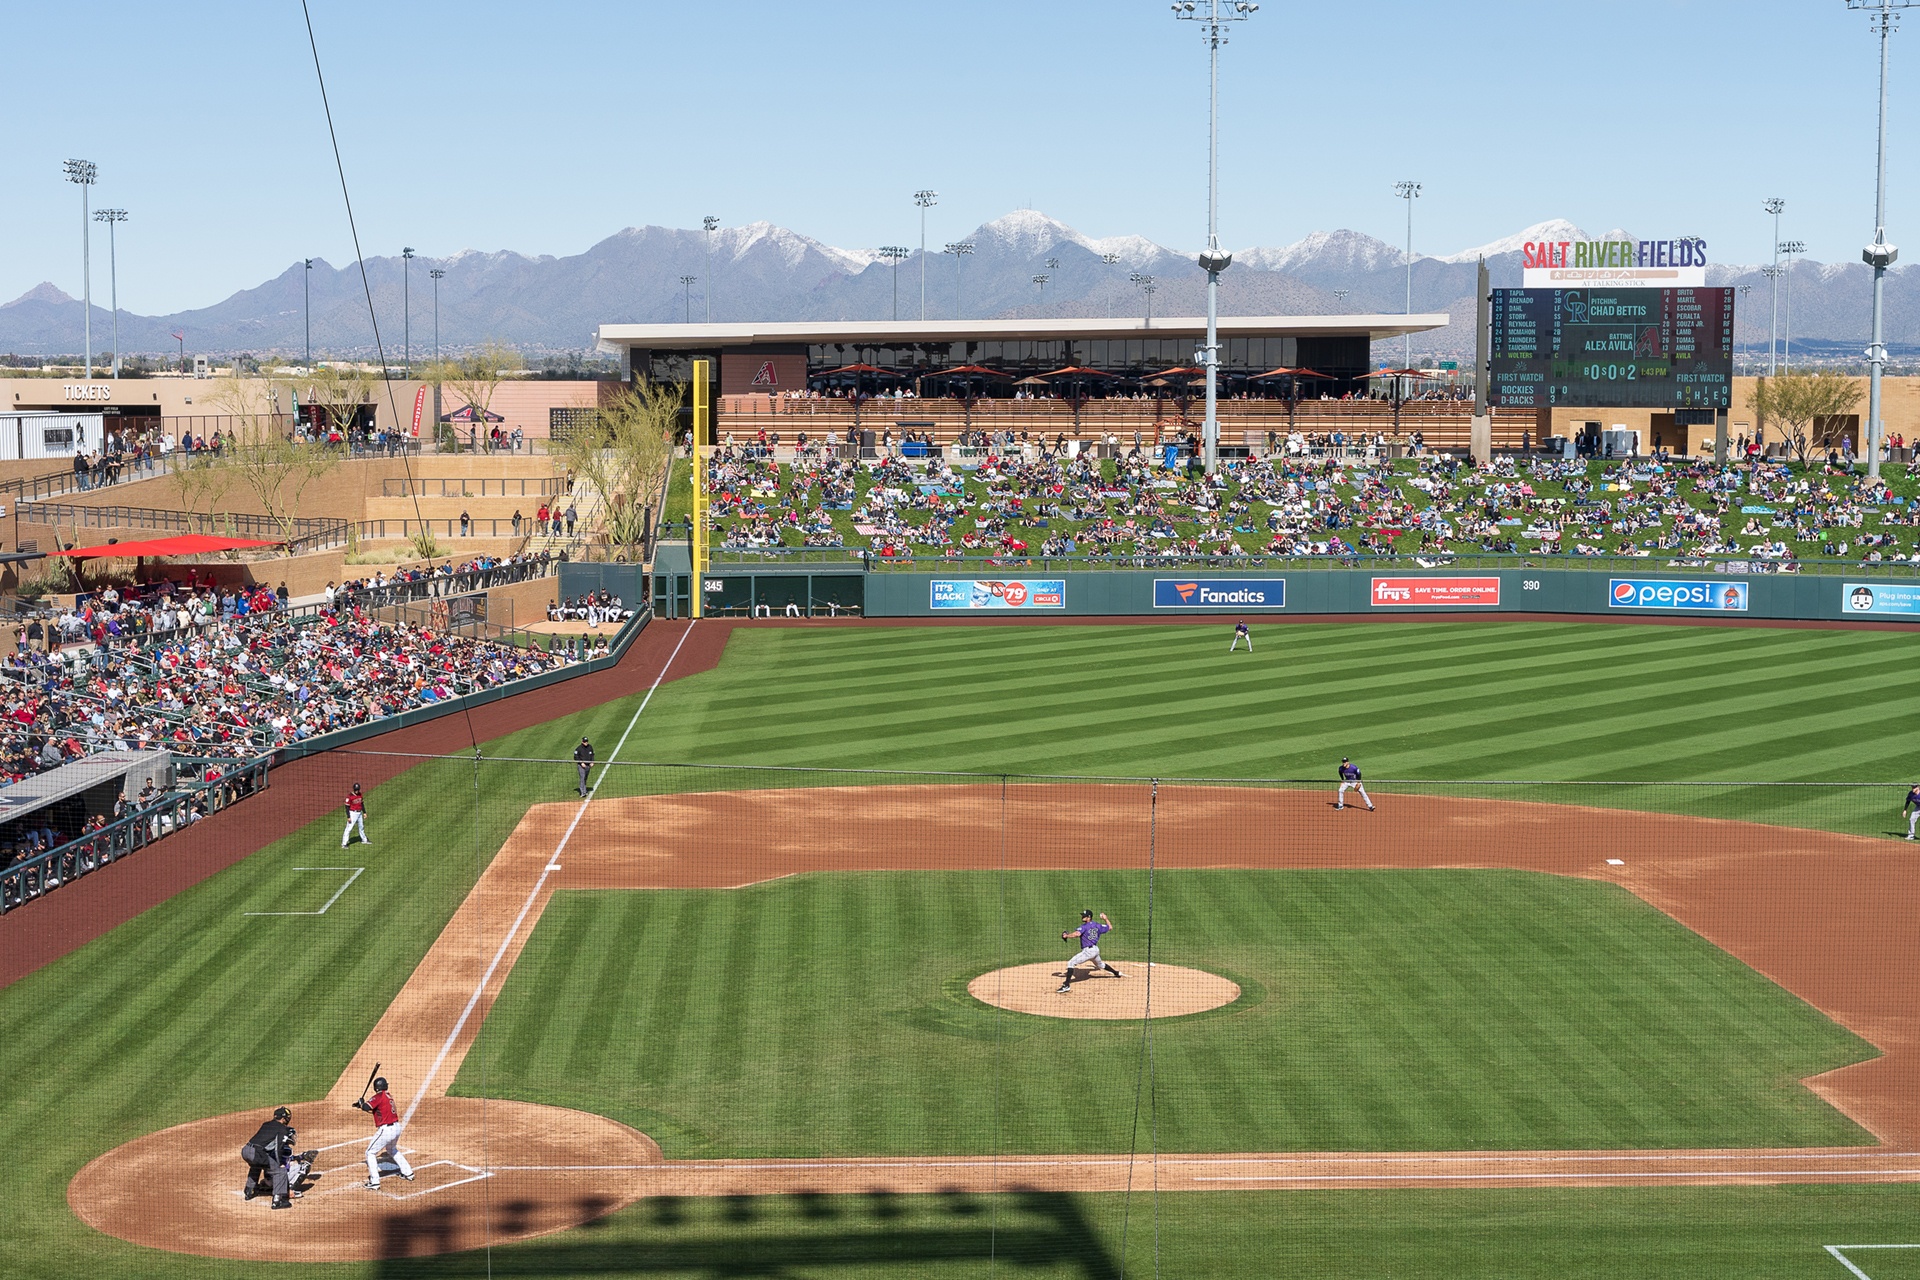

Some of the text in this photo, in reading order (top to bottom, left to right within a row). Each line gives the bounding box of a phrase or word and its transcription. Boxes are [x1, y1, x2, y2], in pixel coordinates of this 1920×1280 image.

[1523, 240, 1707, 269] SALT RIVER FIELDS
[1591, 306, 1646, 316] CHAD BETTIS
[1585, 341, 1633, 350] ALEX AVILA
[1584, 367, 1589, 376] B
[1591, 364, 1599, 380] 0
[1602, 367, 1607, 376] S
[1608, 364, 1617, 380] 0
[1627, 364, 1636, 380] 2
[1641, 368, 1666, 376] 1:43 PM
[1497, 373, 1544, 381] FIRST WATCH
[1676, 374, 1724, 382] FIRST WATCH
[64, 385, 110, 400] TICKETS
[1502, 386, 1568, 394] ROCKIES 0 0
[1686, 386, 1690, 394] 0
[1722, 386, 1727, 394] 0
[1501, 396, 1534, 404] D-BACKS
[1550, 395, 1555, 403] 3
[1677, 391, 1718, 399] R H E
[1686, 397, 1727, 405] 3 3 0
[705, 581, 722, 590] 345
[935, 584, 953, 592] IT'S
[1523, 581, 1540, 590] 390
[1200, 588, 1264, 603] Fanatics
[1375, 582, 1411, 601] fry's
[1639, 584, 1710, 606] pepsi
